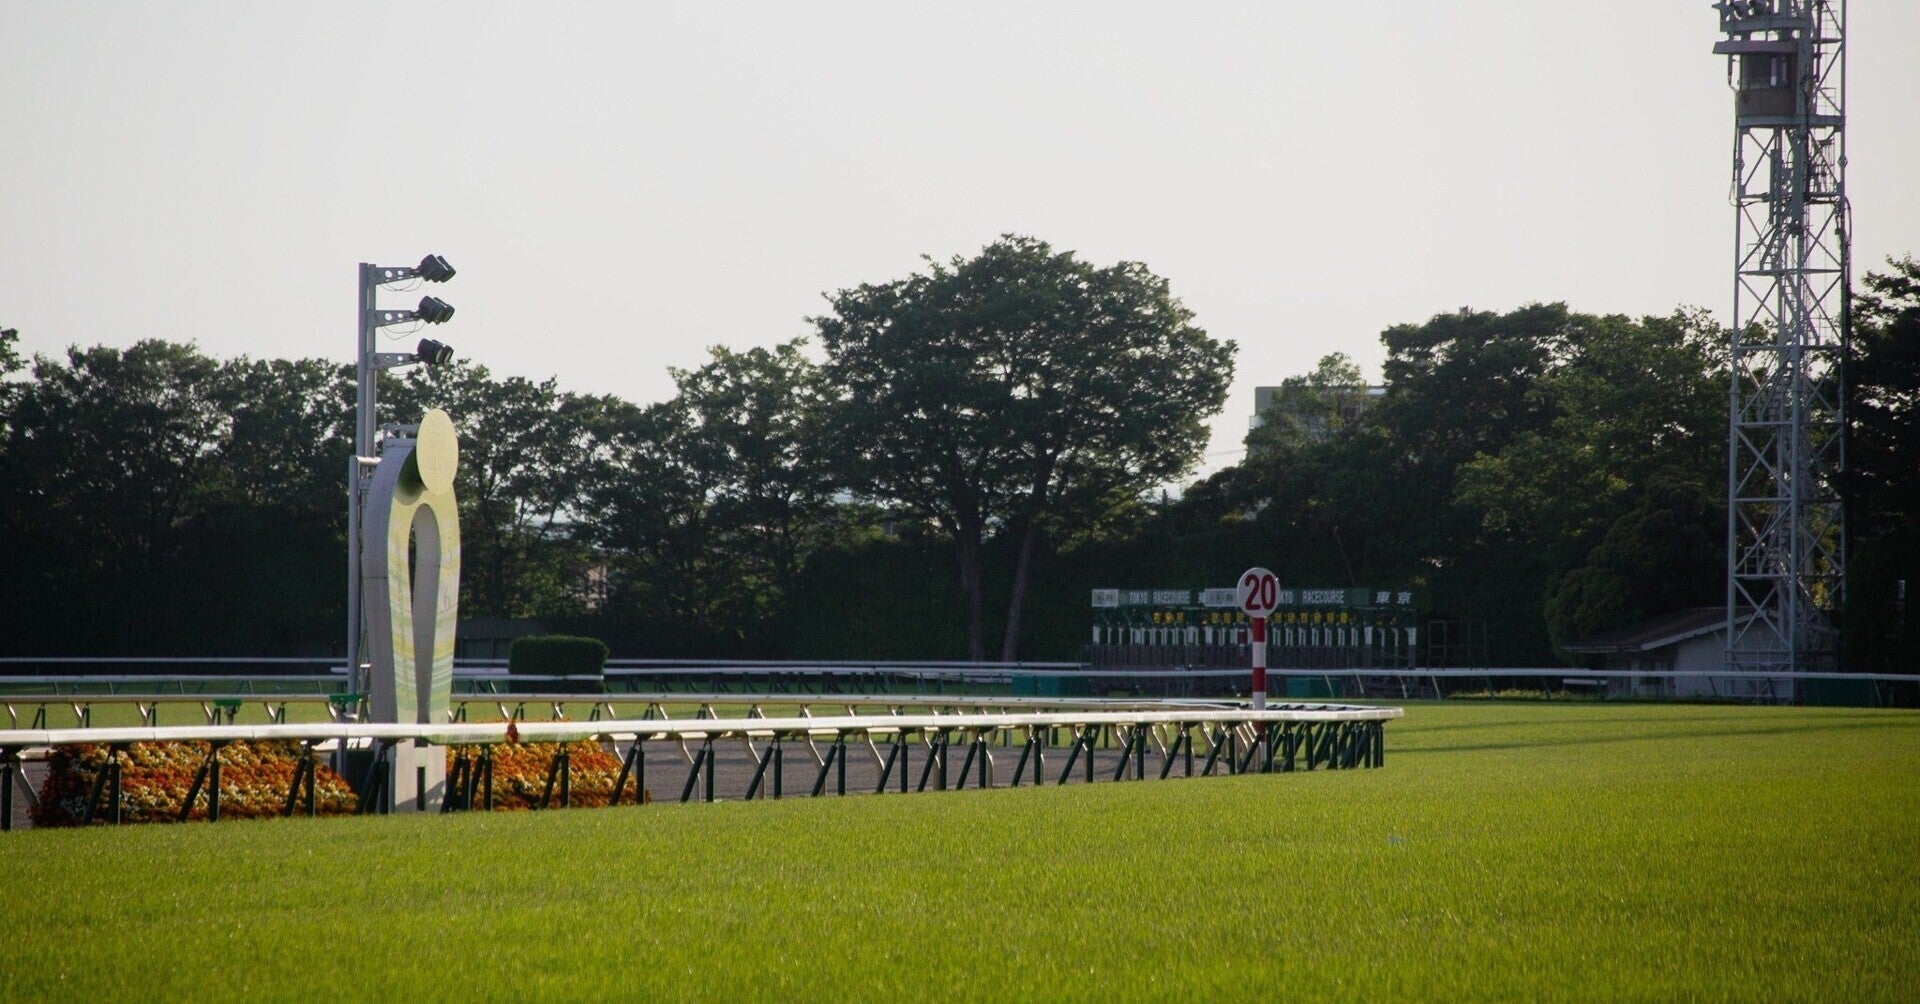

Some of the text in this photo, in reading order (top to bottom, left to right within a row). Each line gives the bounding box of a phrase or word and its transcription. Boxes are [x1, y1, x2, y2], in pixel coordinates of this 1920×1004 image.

[1129, 590, 1148, 604] TOKYO
[1152, 590, 1190, 604] RACECOURSE
[1245, 574, 1276, 610] 20
[1280, 590, 1345, 604] KYO RACECOURSE
[1375, 590, 1412, 604] 東京
